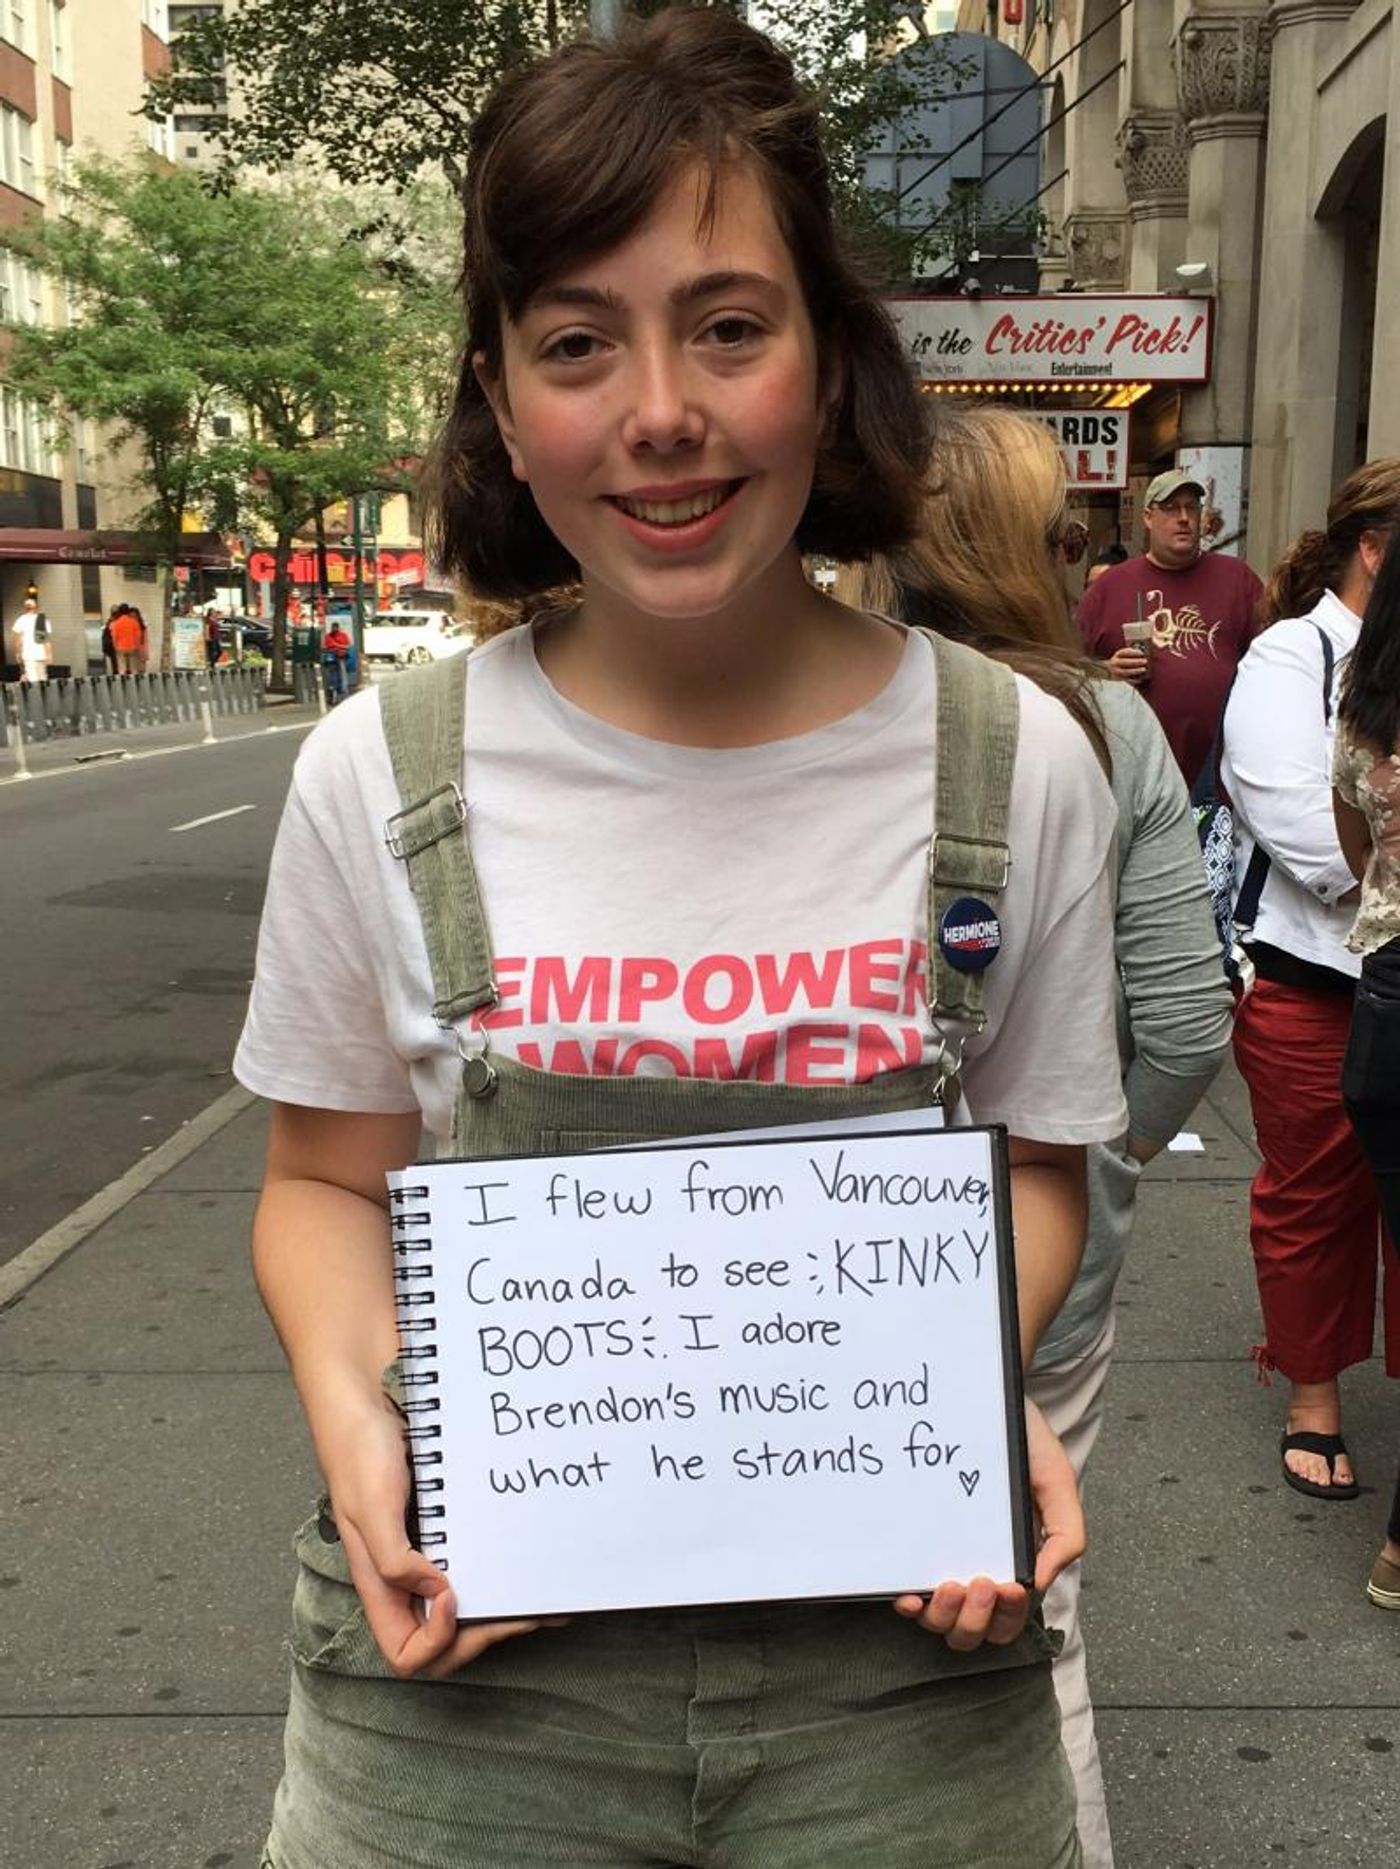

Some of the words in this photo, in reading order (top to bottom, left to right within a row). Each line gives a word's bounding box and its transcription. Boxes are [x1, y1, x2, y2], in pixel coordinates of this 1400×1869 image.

[911, 332, 931, 355] is
[936, 328, 972, 355] the
[985, 314, 1106, 355] Critics'
[1105, 314, 1205, 355] Pick!
[944, 920, 999, 944] HERMIONE
[464, 1182, 517, 1226] I
[547, 1173, 652, 1218] flew
[681, 1161, 784, 1216] from
[467, 1258, 636, 1305] Canada
[661, 1252, 699, 1288] to
[724, 1260, 791, 1287] see
[835, 1230, 989, 1297] KINKY
[679, 1314, 719, 1351] I
[742, 1313, 841, 1348] adore
[490, 1382, 696, 1437] Brendon's
[719, 1380, 829, 1416] music
[853, 1362, 929, 1410] and
[489, 1452, 612, 1494] what
[651, 1444, 706, 1481] he
[732, 1435, 884, 1481] stands
[903, 1420, 961, 1468] for
